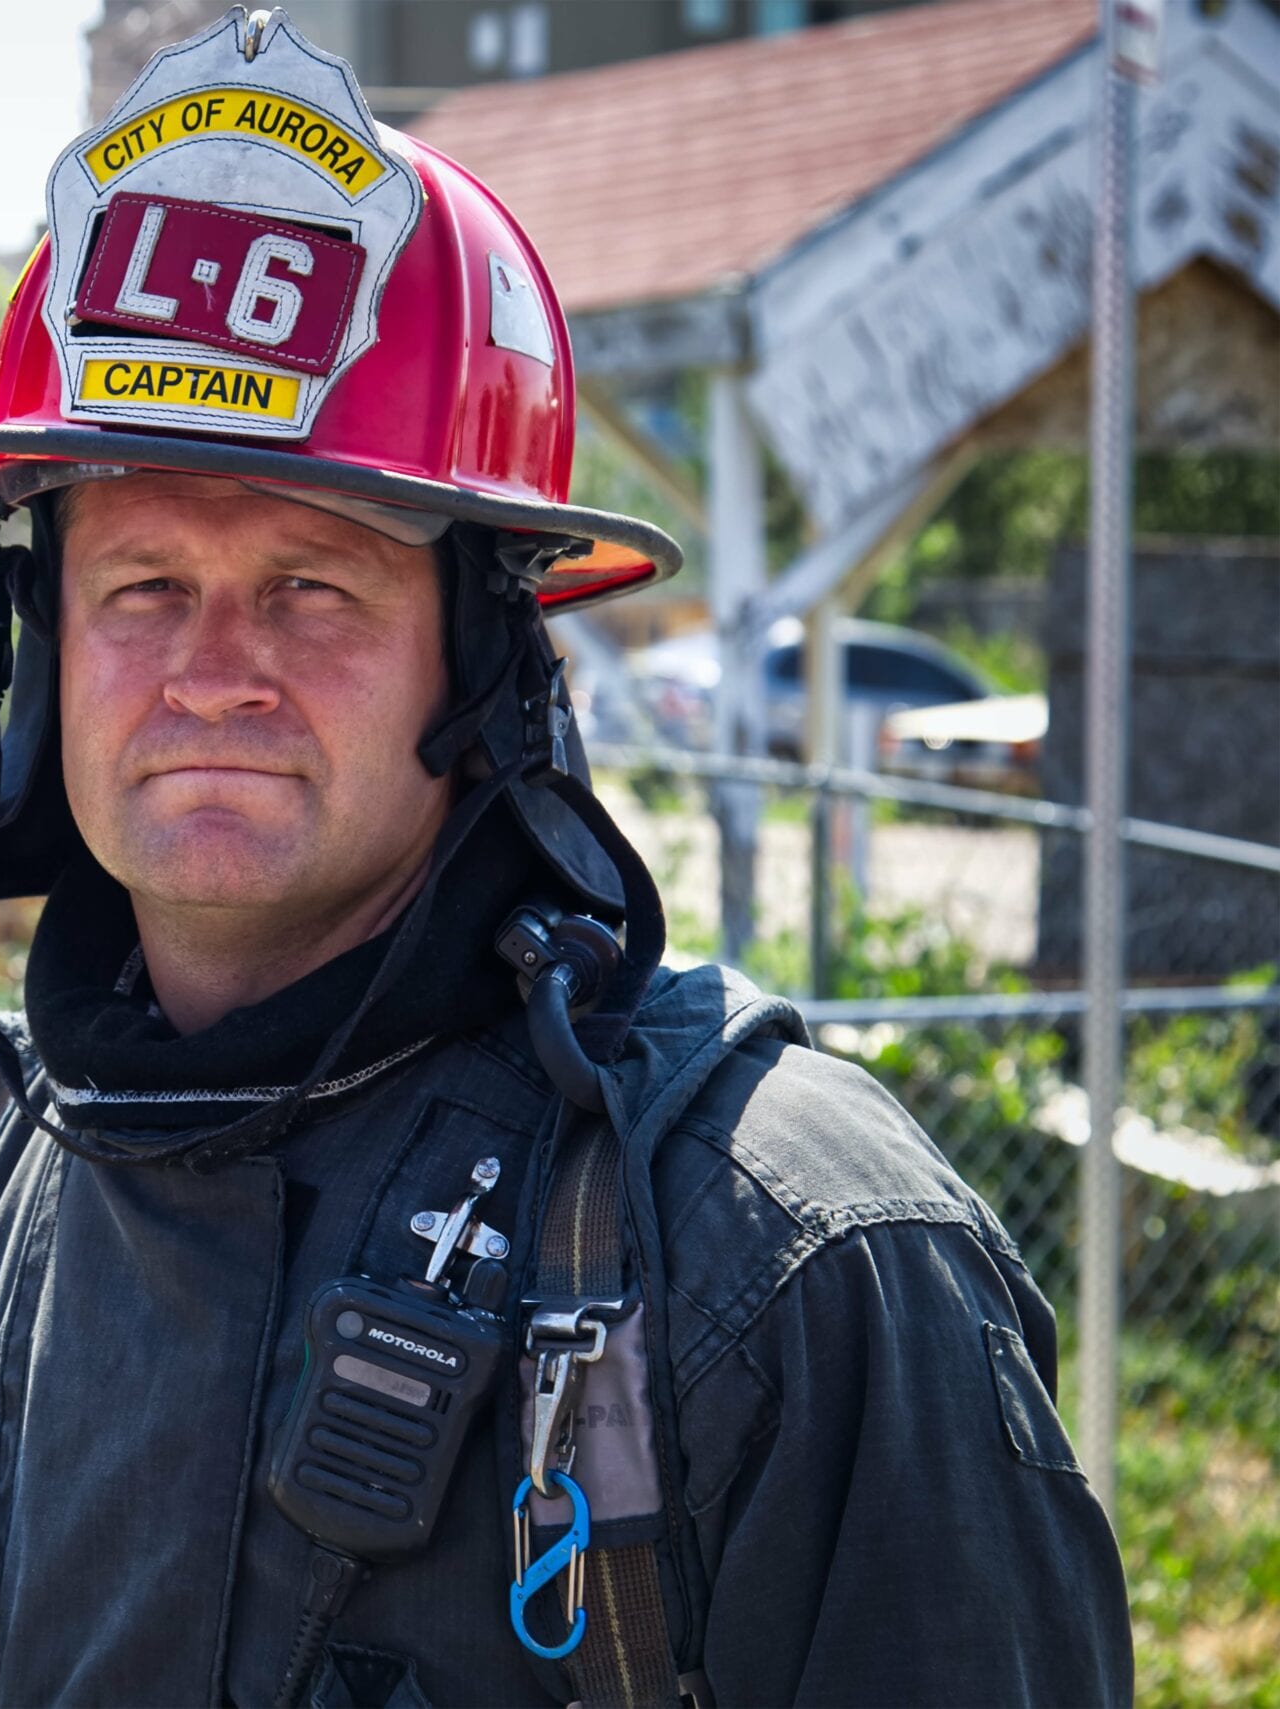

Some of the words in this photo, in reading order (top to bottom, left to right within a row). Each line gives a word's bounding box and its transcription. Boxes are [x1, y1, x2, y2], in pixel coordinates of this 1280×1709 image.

[103, 113, 166, 172] CITY
[181, 98, 226, 132] OF
[235, 99, 367, 185] AURORA
[104, 363, 274, 410] CAPTAIN
[367, 1327, 458, 1368] MOTOROLA
